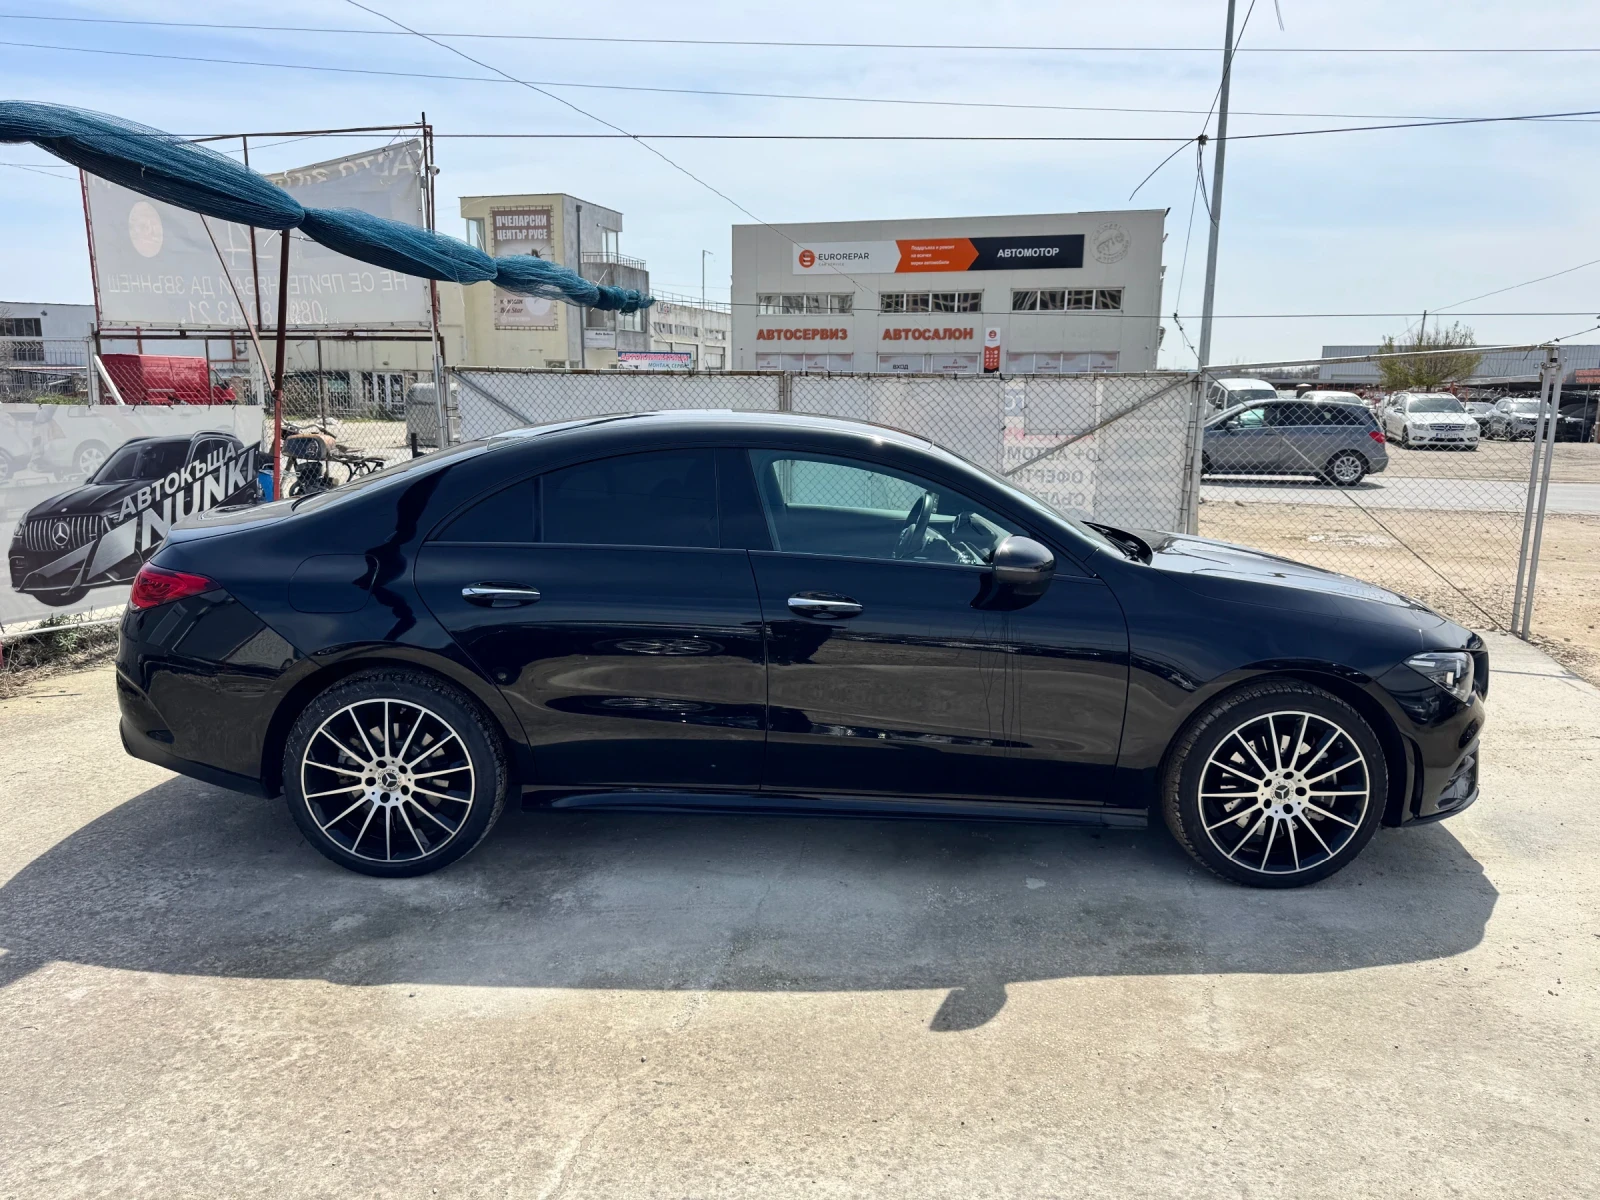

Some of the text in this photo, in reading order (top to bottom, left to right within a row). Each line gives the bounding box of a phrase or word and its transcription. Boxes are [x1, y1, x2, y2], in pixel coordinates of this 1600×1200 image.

[496, 214, 547, 227] ПЧЕЛАРСКИ
[497, 229, 547, 241] ЦЕНТЪР РУСЕ
[818, 253, 870, 261] EUROREPAR
[997, 246, 1060, 259] АВТОМОТОР
[756, 328, 848, 341] АВТОСЕРВИЗ
[882, 328, 974, 341] АВТОСАЛОН
[118, 441, 237, 522] АВТОКЪЩА
